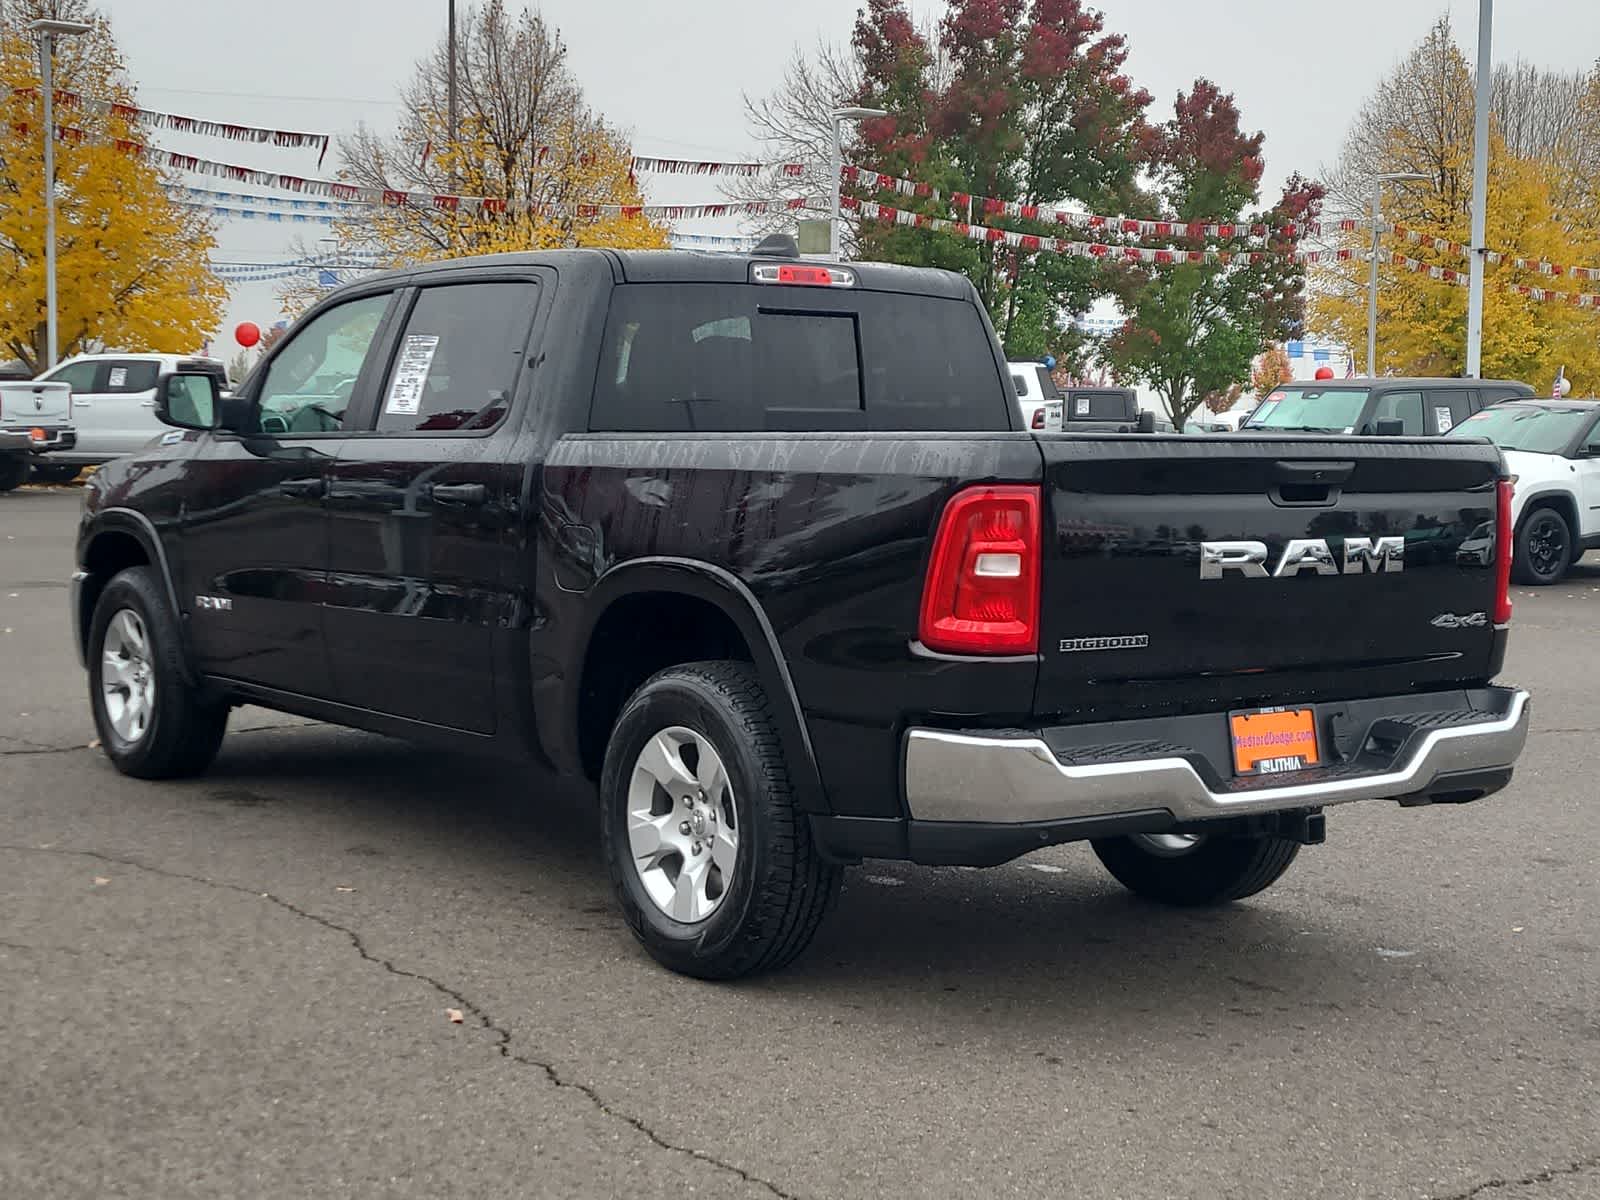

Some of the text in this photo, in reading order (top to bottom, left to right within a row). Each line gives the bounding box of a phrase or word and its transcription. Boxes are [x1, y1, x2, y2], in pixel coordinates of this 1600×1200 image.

[1200, 537, 1405, 579] RAM
[1060, 635, 1148, 652] BIGHORN
[1270, 756, 1301, 772] LITHIA
